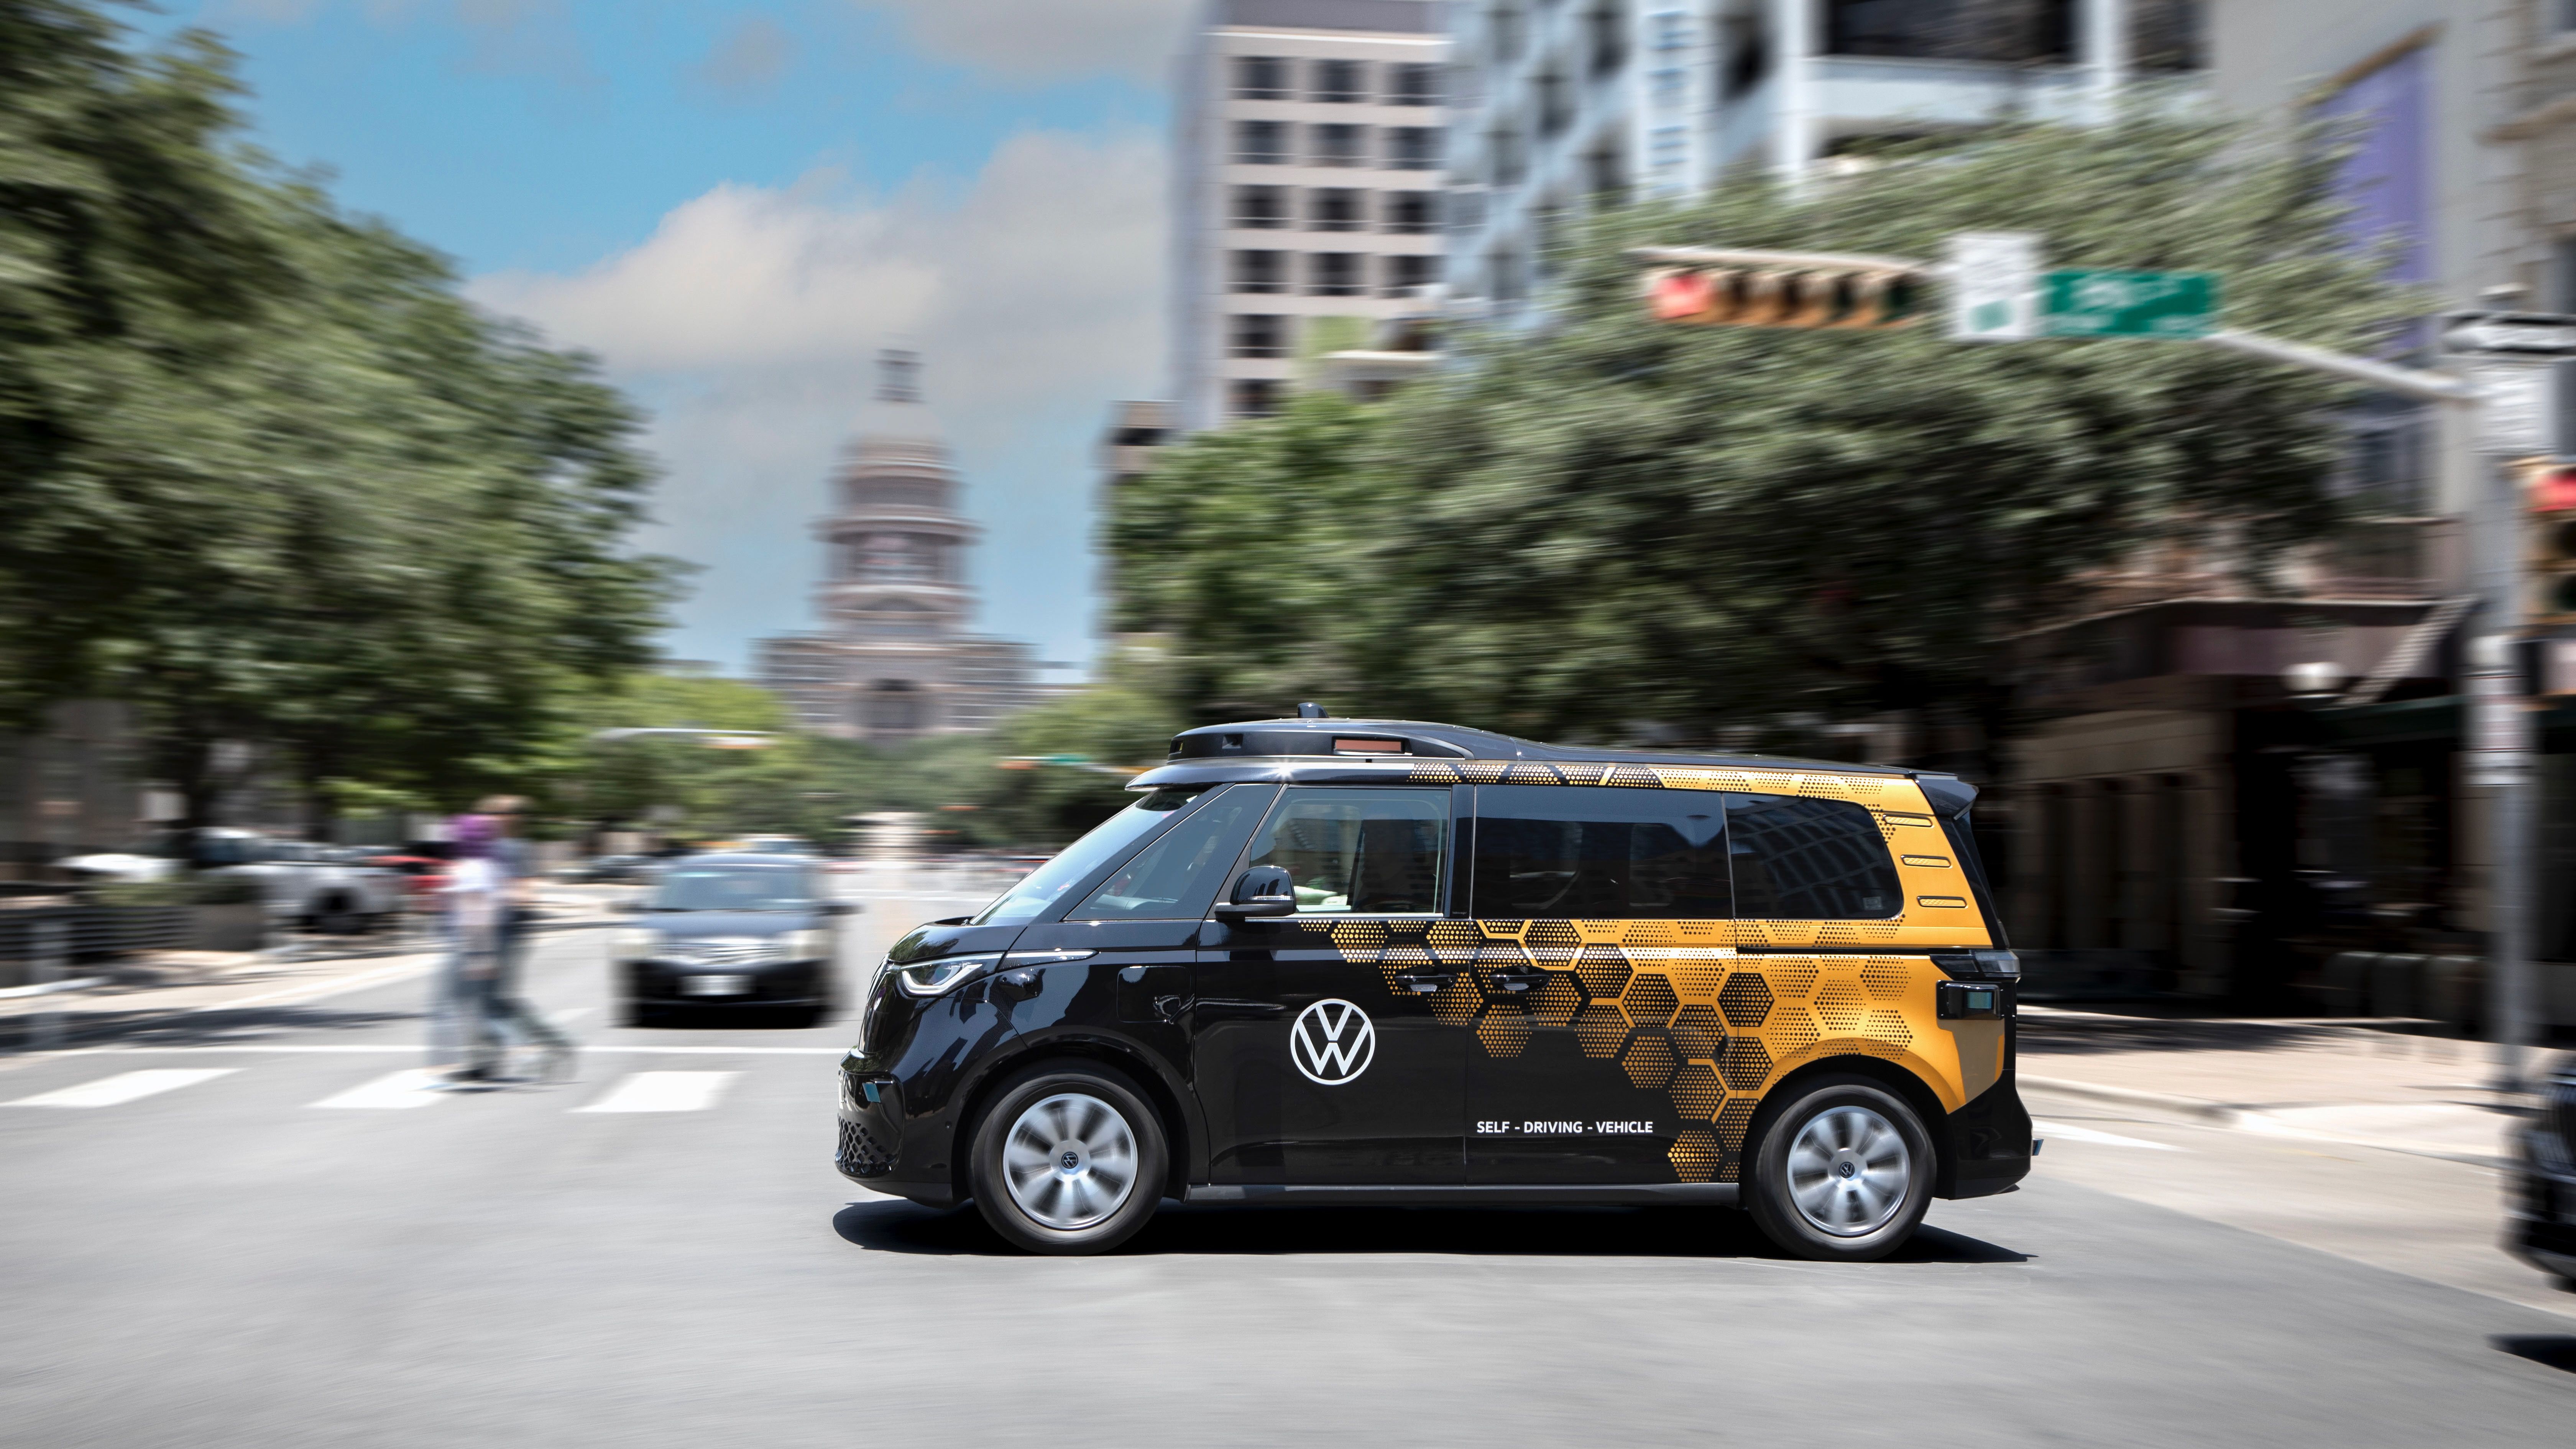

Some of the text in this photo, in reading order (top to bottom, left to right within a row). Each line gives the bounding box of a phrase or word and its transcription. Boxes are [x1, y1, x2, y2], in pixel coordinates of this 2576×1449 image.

[1291, 999, 1375, 1084] VW
[1477, 1121, 1510, 1133] SELF
[1524, 1121, 1582, 1133] DRIVING
[1596, 1121, 1653, 1133] VEHICLE
